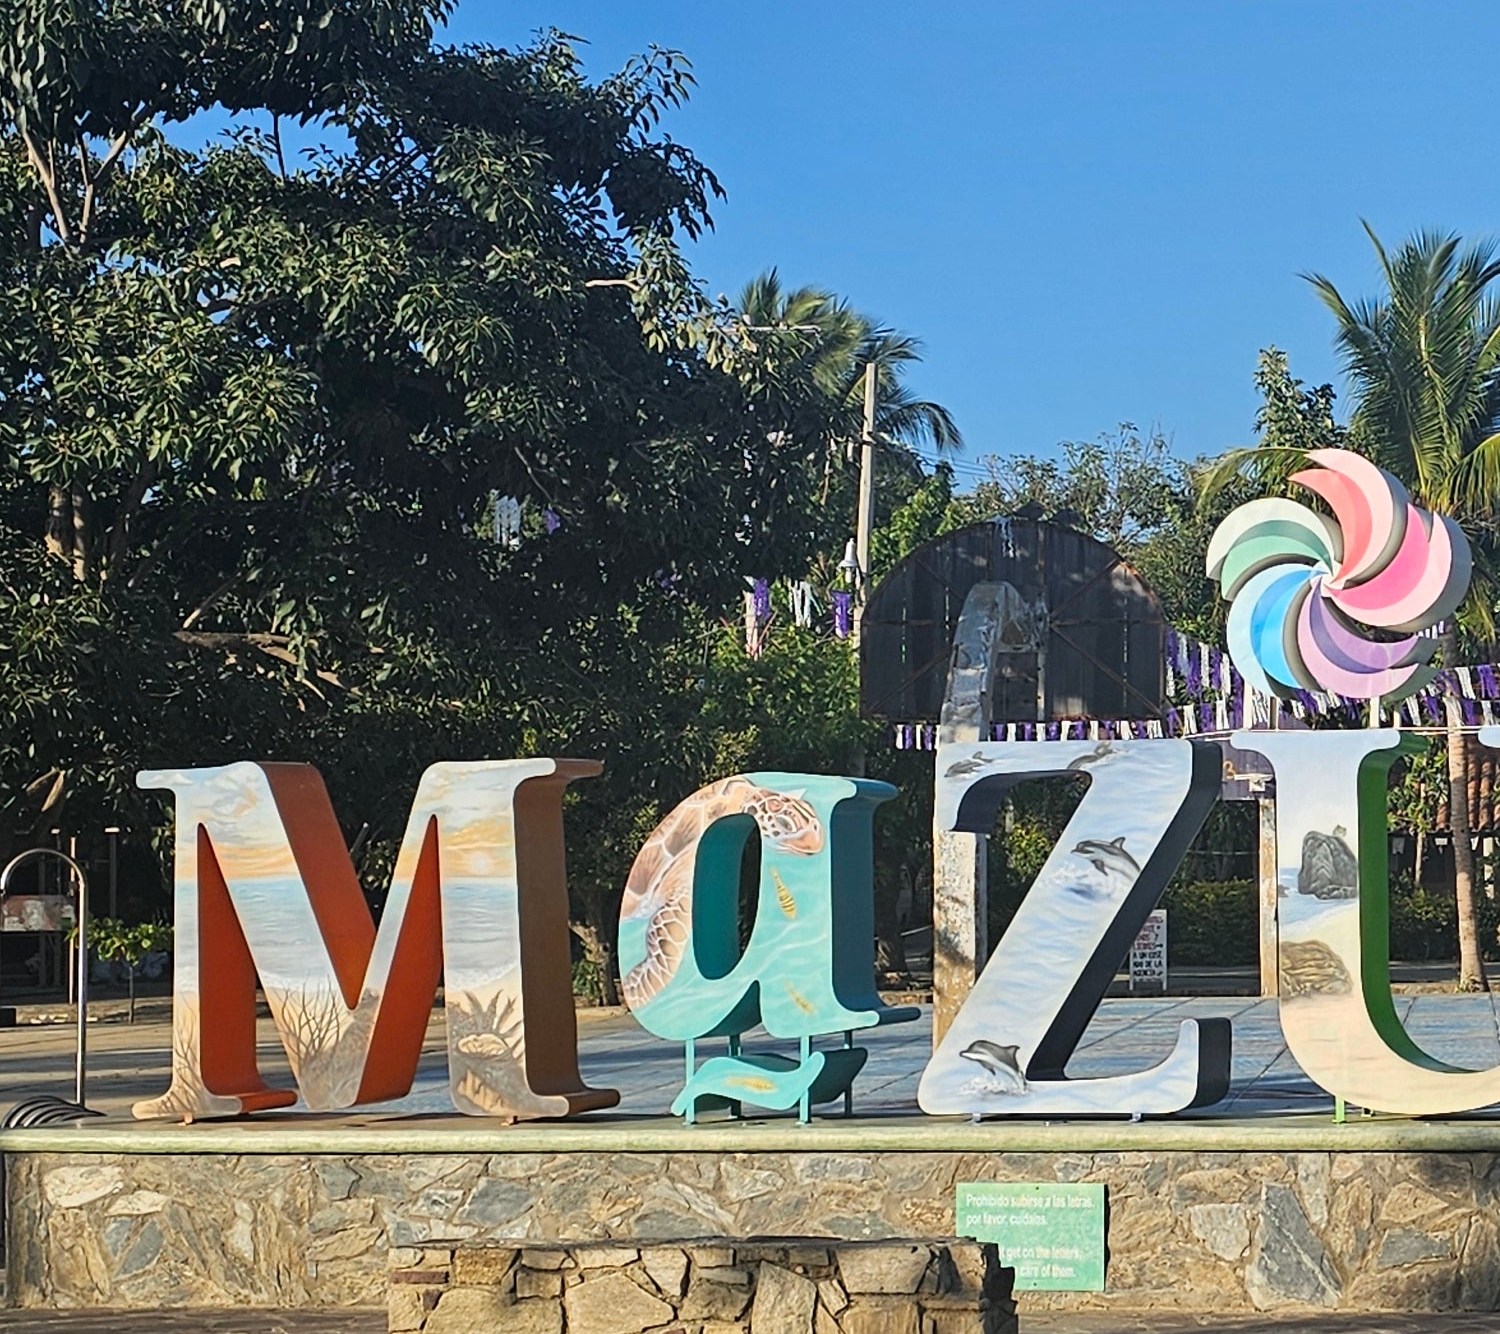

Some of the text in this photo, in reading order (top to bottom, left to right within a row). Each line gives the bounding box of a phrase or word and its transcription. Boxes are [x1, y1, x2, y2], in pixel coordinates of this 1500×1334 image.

[966, 1194, 1009, 1208] Prohibido
[1010, 1194, 1043, 1208] subirse
[1044, 1197, 1051, 1208] a
[1052, 1194, 1066, 1208] las
[966, 1214, 982, 1228] por
[1006, 1246, 1020, 1261] get
[1021, 1248, 1035, 1259] on
[1036, 1246, 1051, 1259] the
[1020, 1266, 1039, 1278] care
[1040, 1264, 1051, 1278] of
